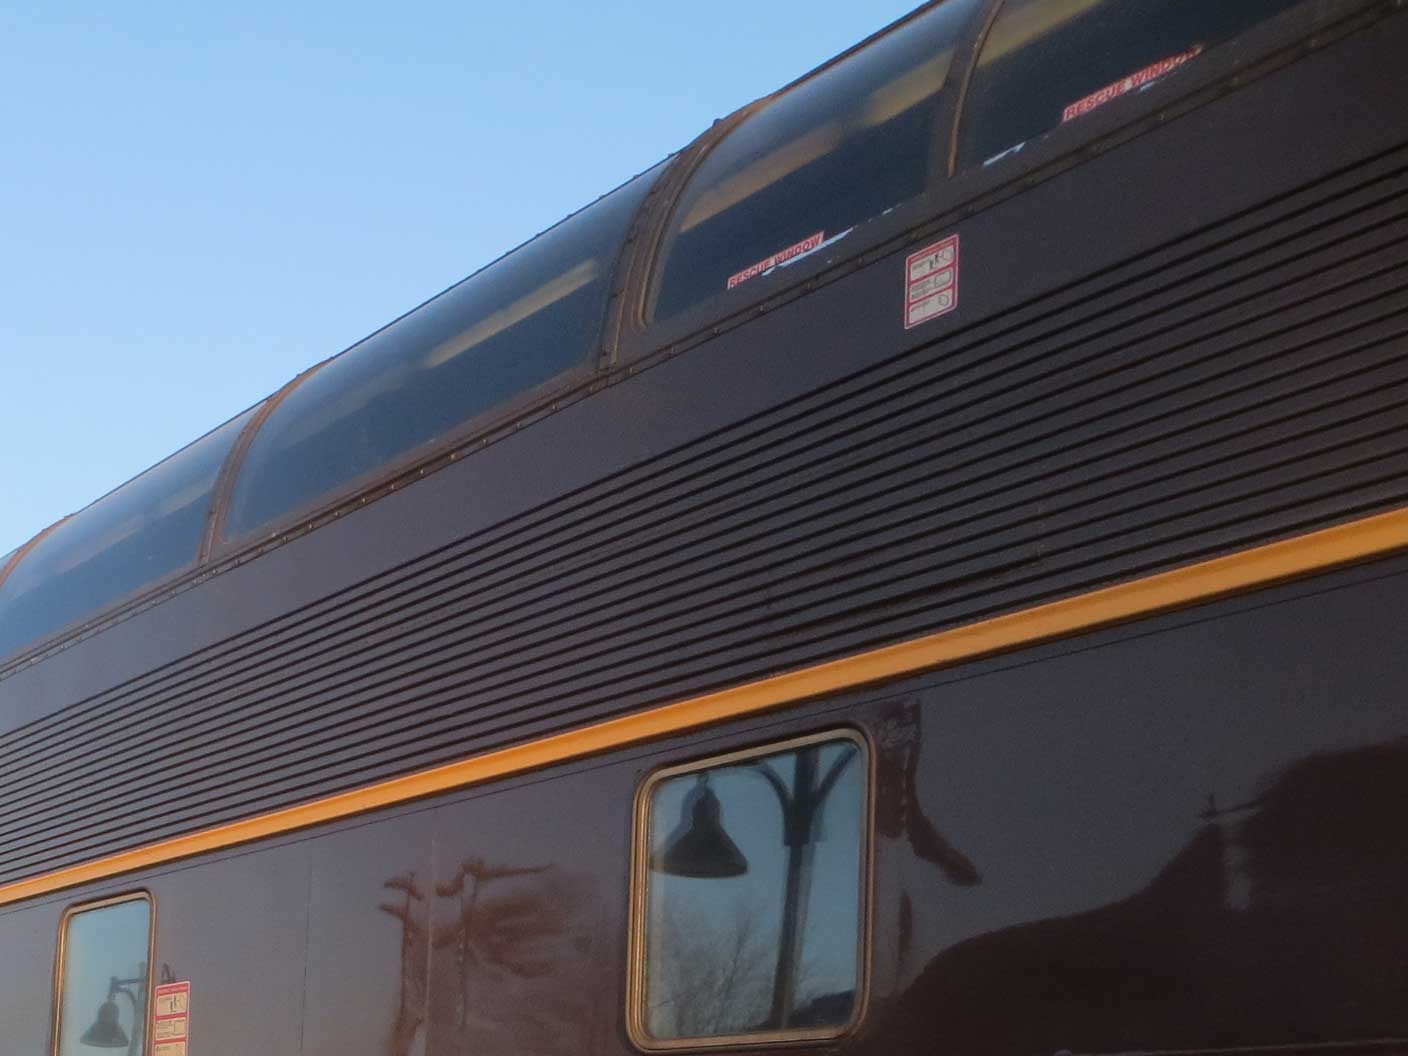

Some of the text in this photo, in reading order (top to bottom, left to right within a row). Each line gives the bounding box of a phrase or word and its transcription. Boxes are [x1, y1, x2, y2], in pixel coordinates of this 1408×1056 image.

[1066, 79, 1126, 119] RESCUE
[729, 236, 821, 289] RESCUE WINDOW
